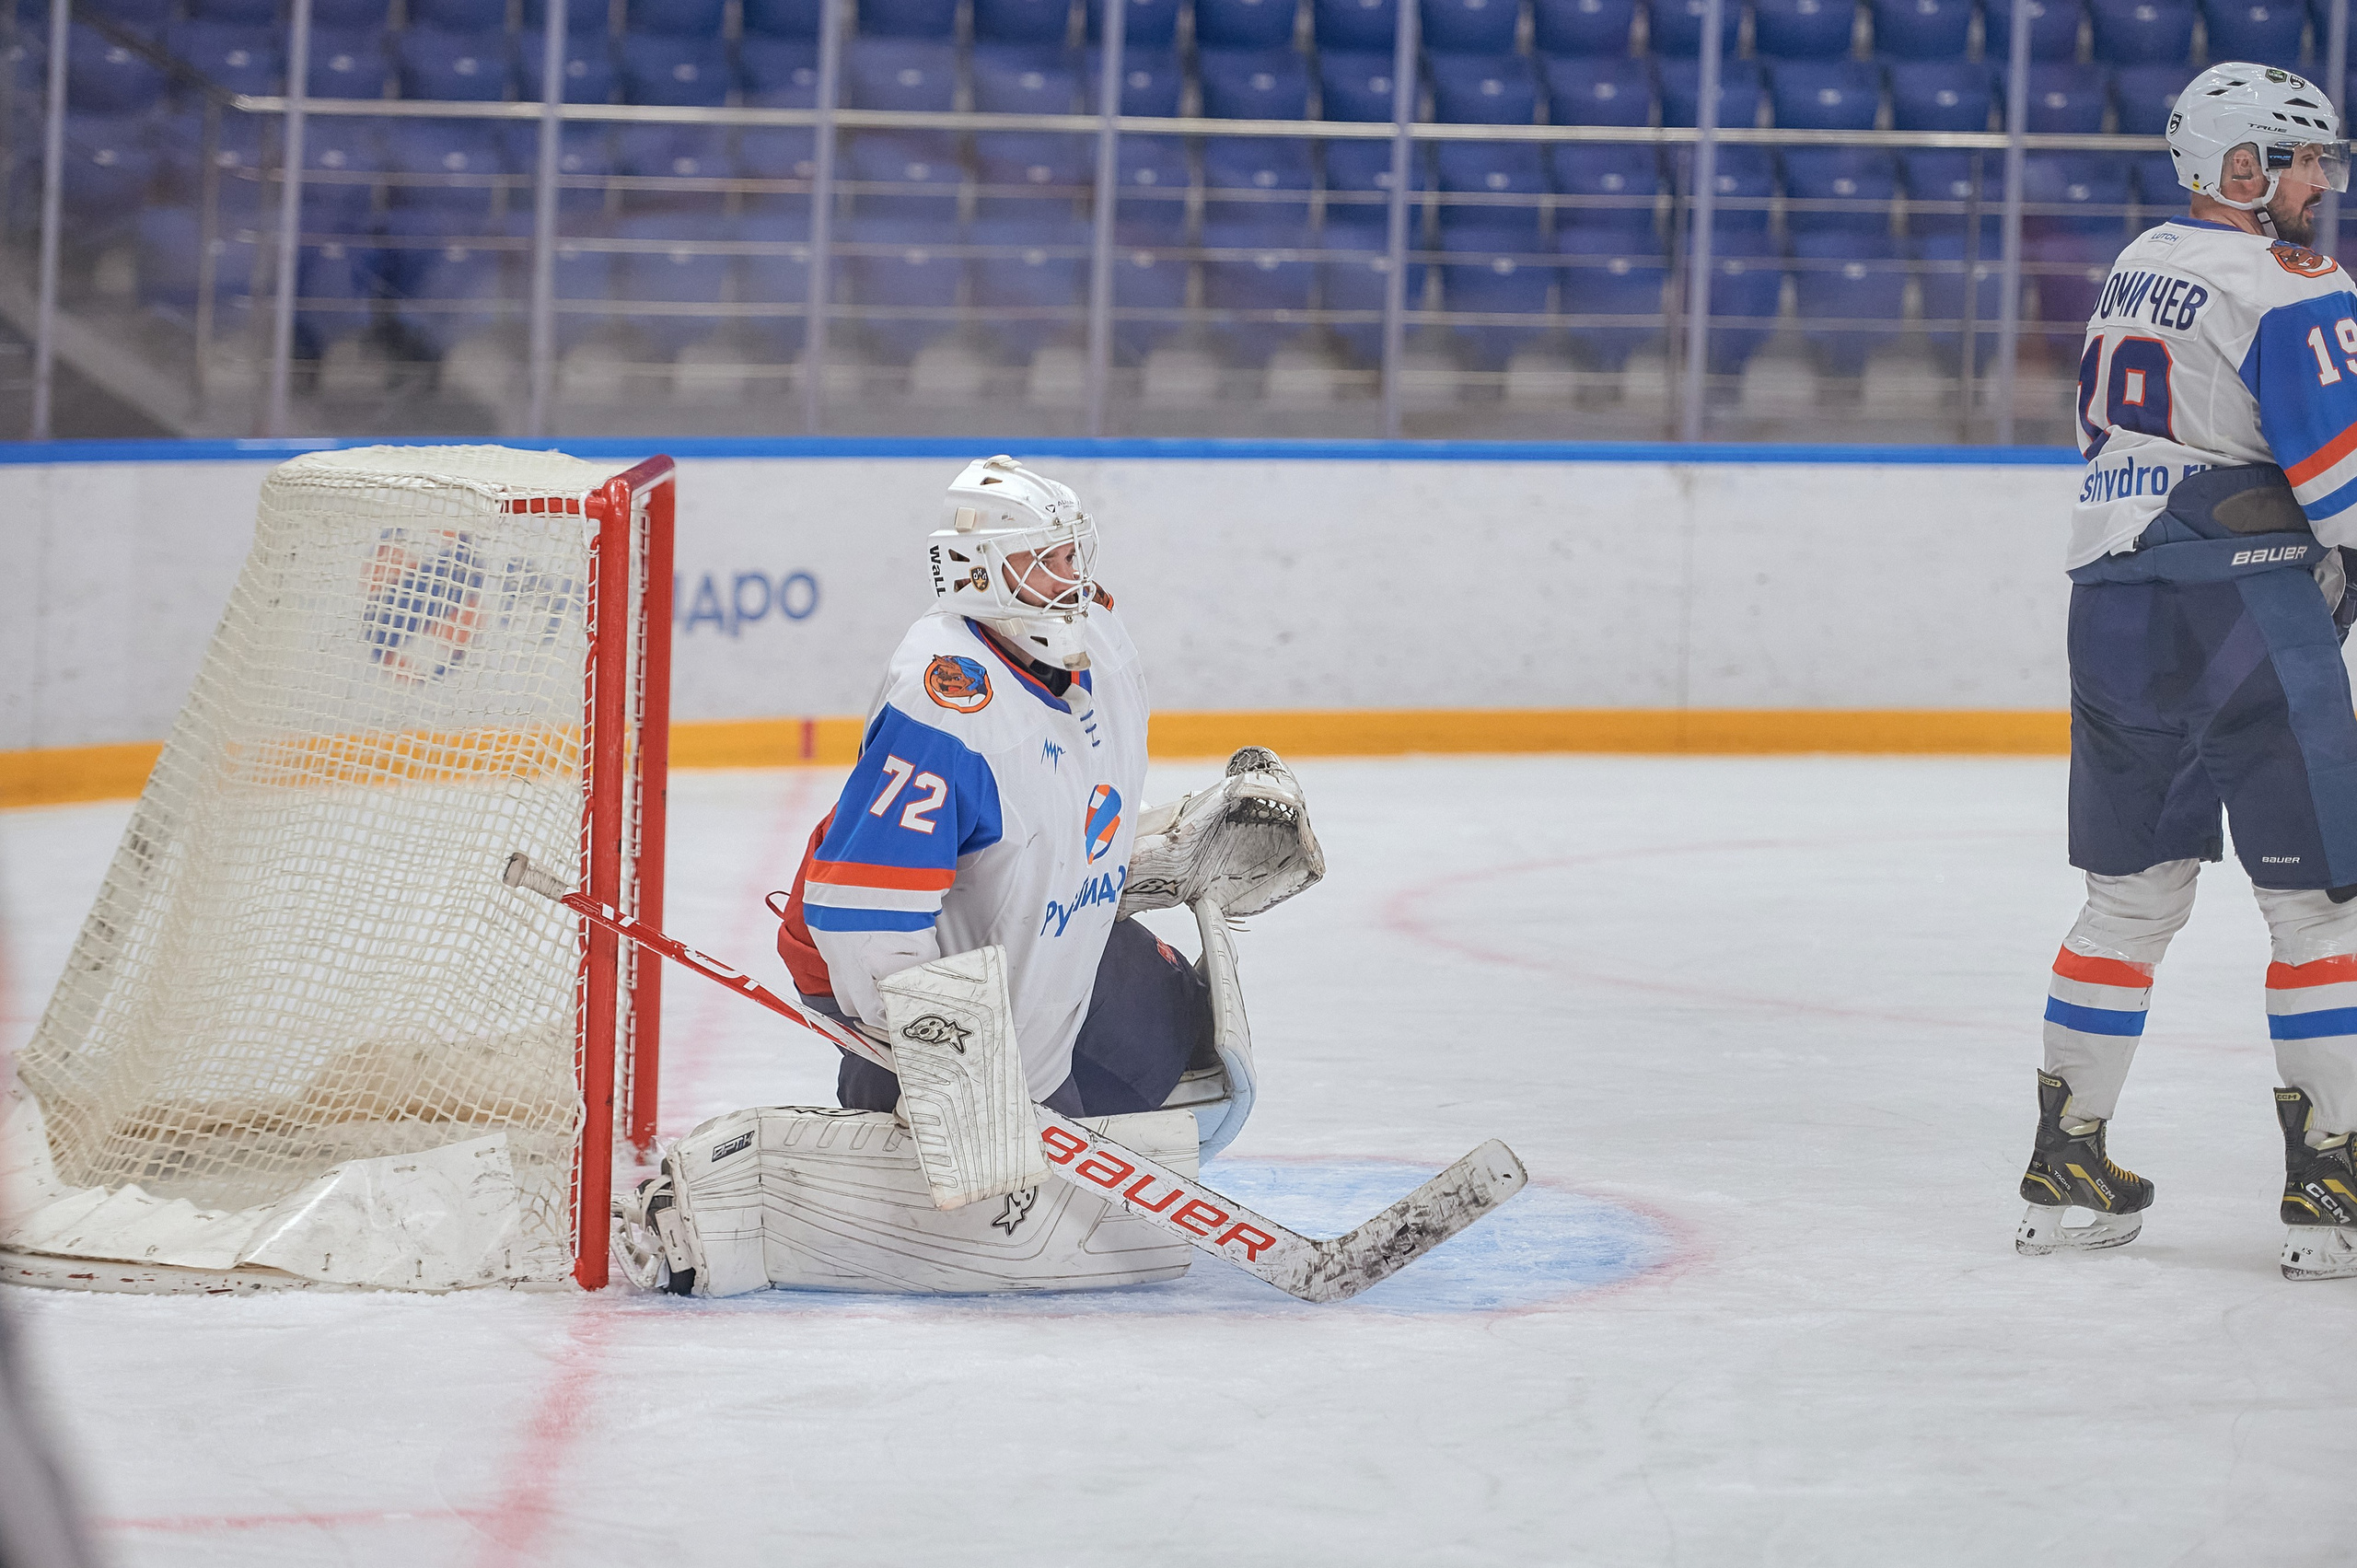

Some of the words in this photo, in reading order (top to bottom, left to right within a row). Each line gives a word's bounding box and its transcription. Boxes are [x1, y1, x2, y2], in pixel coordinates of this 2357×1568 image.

[2247, 122, 2288, 134] TRUE
[2151, 233, 2179, 242] LUTCH
[2093, 271, 2209, 331] ОМИЧЕВ
[2306, 317, 2357, 387] 19
[869, 753, 948, 834] 72
[2038, 1075, 2059, 1086] CCM
[2053, 1169, 2072, 1191] TACKS
[2095, 1178, 2116, 1201] CCM
[2305, 1182, 2351, 1225] CCM
